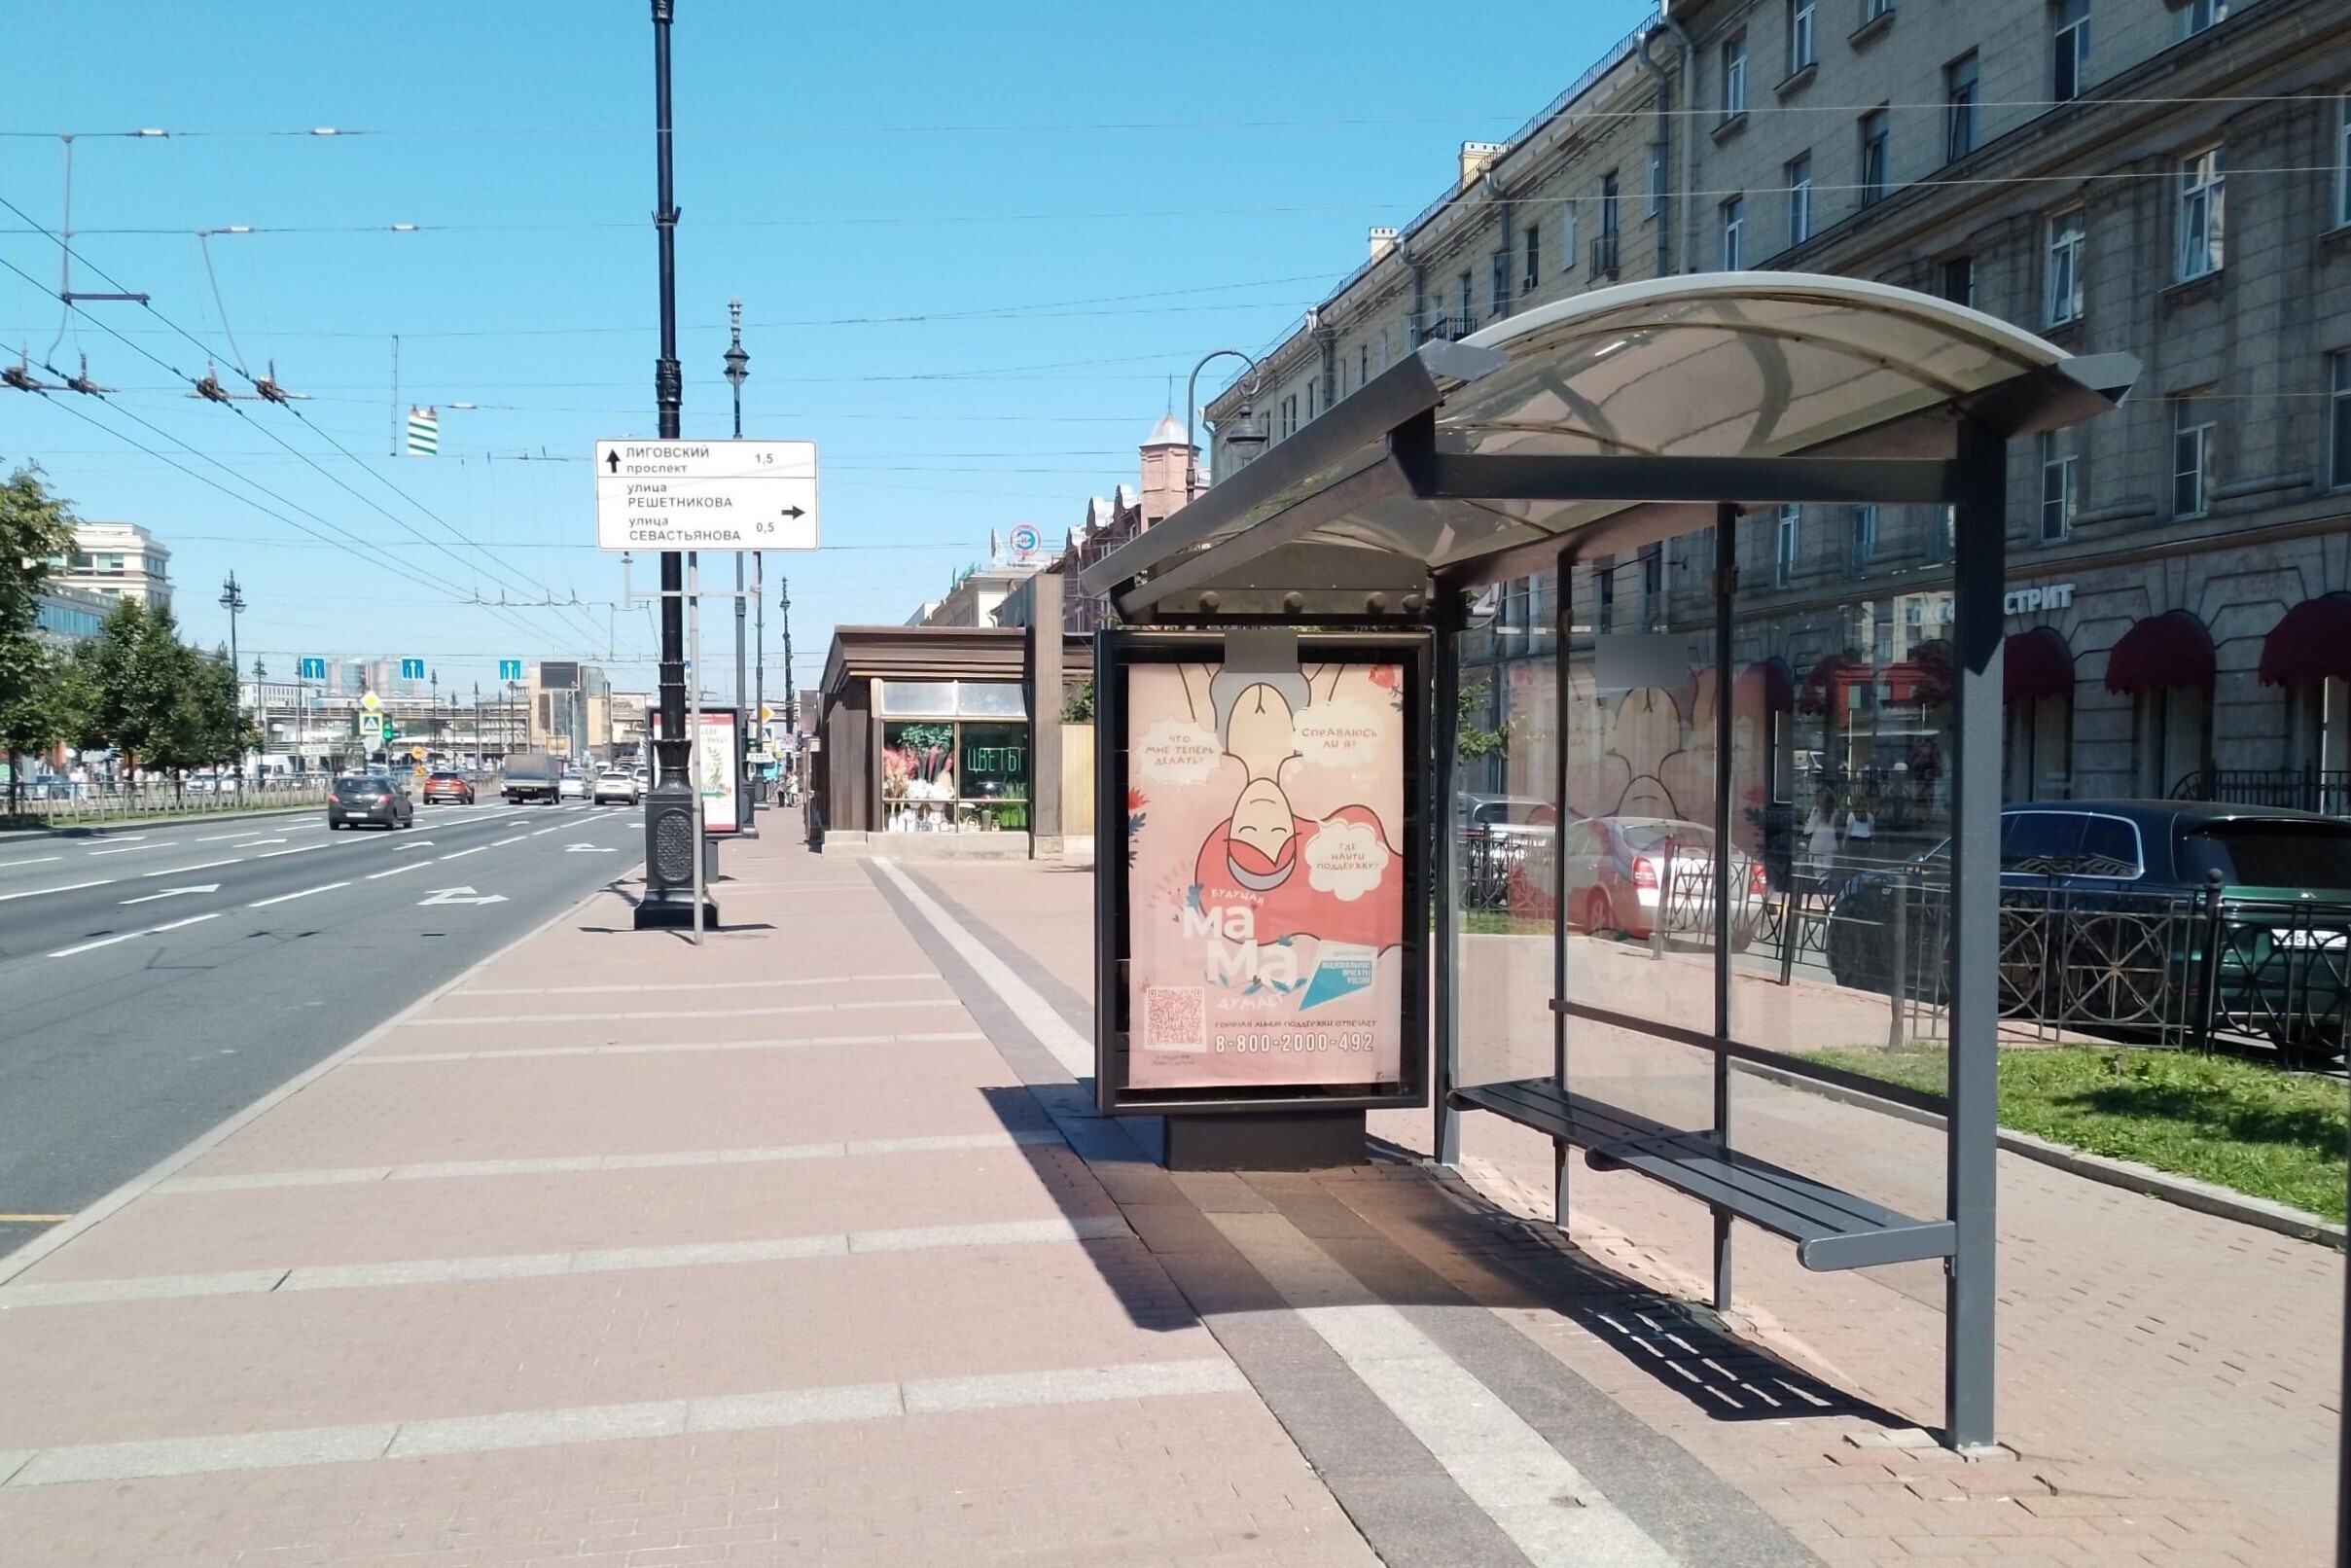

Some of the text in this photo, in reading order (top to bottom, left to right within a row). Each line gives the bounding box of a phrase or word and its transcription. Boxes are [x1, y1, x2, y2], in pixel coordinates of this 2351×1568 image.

[626, 445, 709, 458] ЛИГОВСКИЙ
[756, 453, 773, 465] 1,5
[626, 464, 688, 474] проспект
[627, 484, 667, 495] улица
[628, 497, 732, 508] РЕШЕТНИКОВА
[629, 517, 668, 528] улица
[756, 522, 774, 534] 0,5
[629, 530, 741, 541] СЕВАСТЬЯНОВА
[2004, 584, 2077, 616] СТРИТ
[967, 746, 1022, 774] ЦВЕТЫ
[1155, 757, 1203, 766] ДЕЛАТЬ?
[1211, 888, 1265, 907] БУДУЩАЯ
[1217, 993, 1284, 1011] ДУМАЕТ
[1215, 1032, 1374, 1054] 8-800-2000-492
